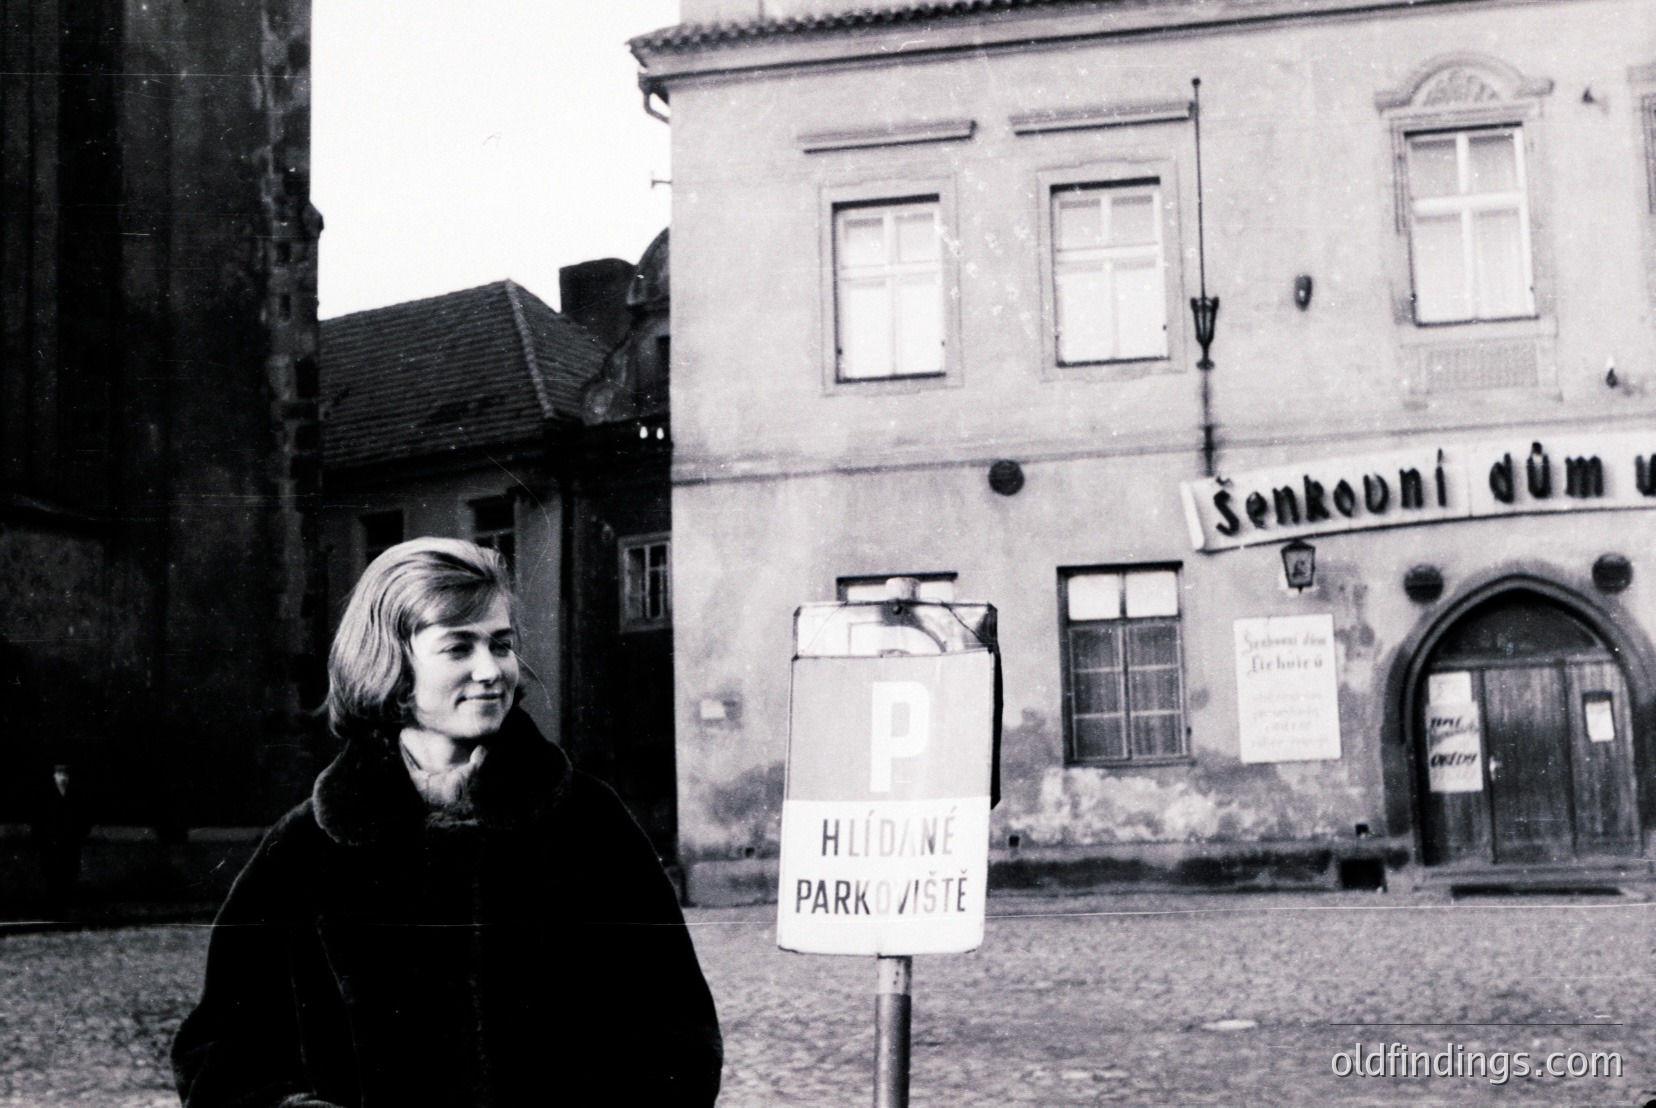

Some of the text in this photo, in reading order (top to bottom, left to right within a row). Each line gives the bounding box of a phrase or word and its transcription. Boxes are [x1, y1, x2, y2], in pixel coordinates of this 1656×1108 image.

[1489, 441, 1605, 504] dům
[869, 681, 930, 793] P
[820, 806, 956, 858] HLÍDANÉ
[794, 868, 968, 916] PARKOVIŠTĚ
